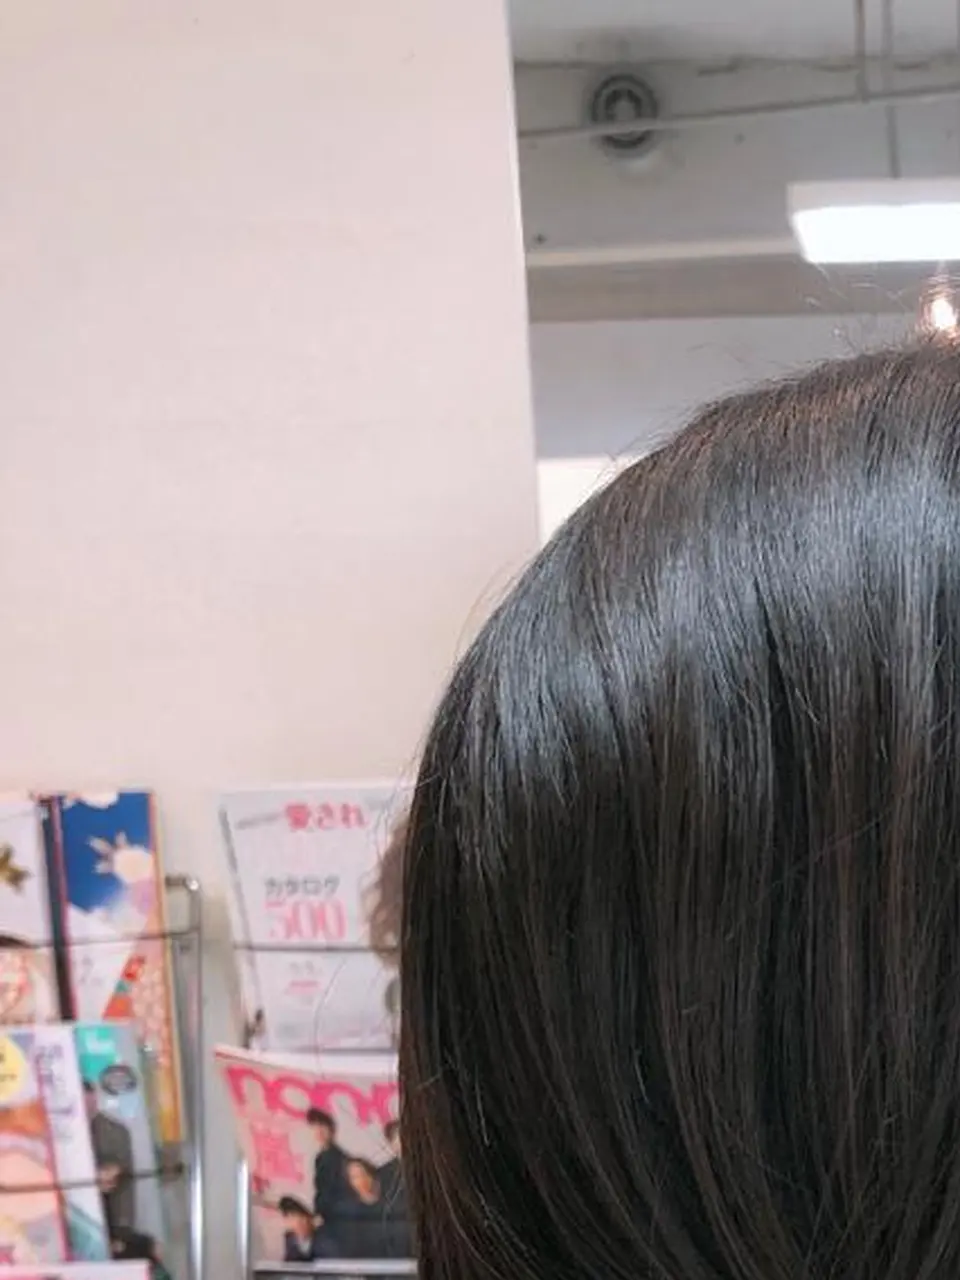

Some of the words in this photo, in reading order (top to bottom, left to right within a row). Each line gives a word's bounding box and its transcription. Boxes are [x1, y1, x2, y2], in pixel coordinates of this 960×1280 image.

[284, 803, 366, 832] 愛され
[265, 875, 340, 896] カタログ
[264, 898, 346, 939] 500
